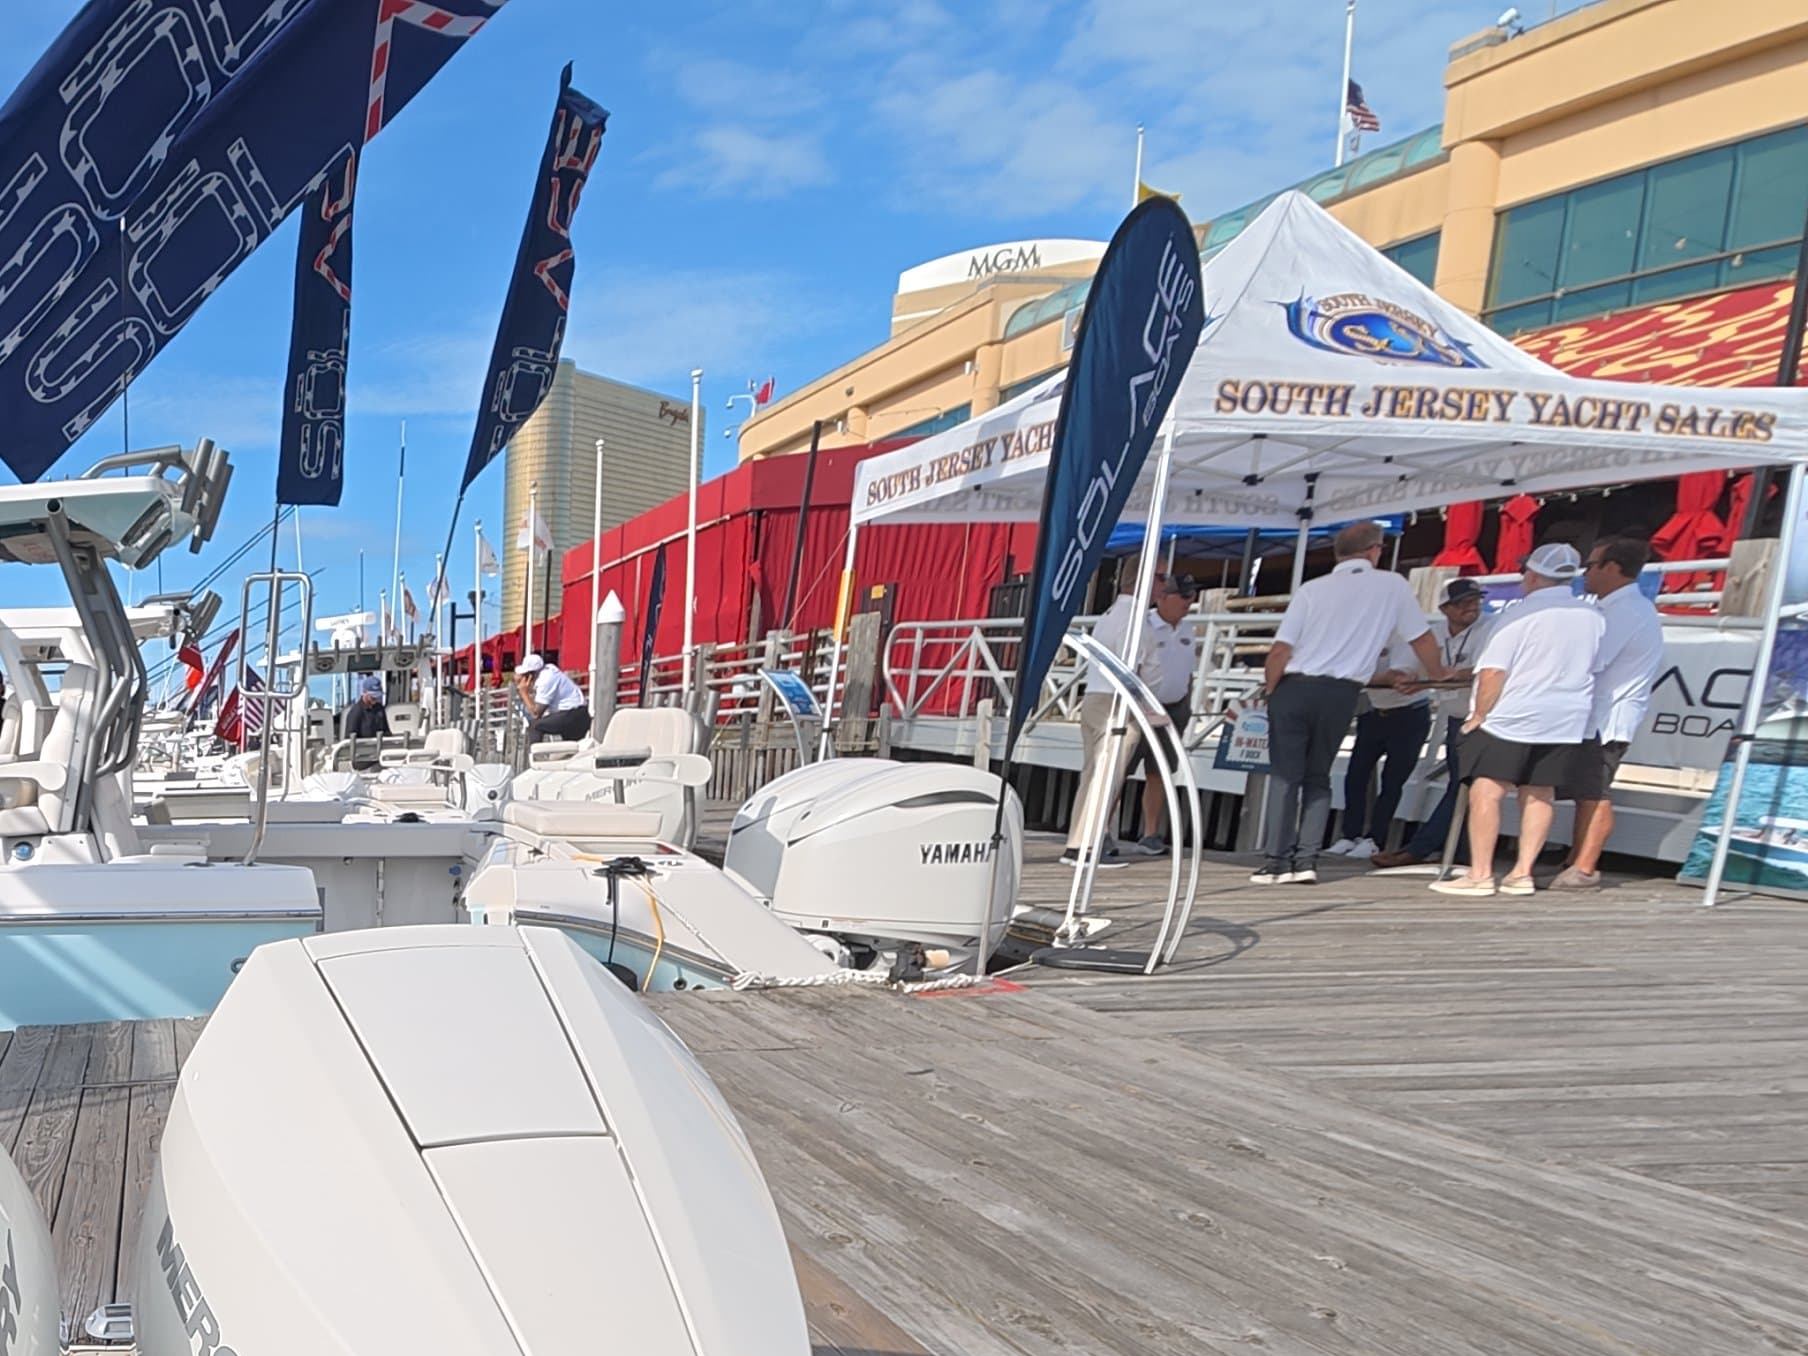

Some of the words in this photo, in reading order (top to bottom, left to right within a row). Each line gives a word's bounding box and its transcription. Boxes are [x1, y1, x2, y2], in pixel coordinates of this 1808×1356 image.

[968, 243, 1041, 277] MGM
[1215, 379, 1353, 418] SOUTH
[1360, 384, 1518, 424] JERSEY
[1524, 393, 1650, 433] YACHT
[1654, 399, 1778, 442] SALES
[867, 465, 921, 507] SOUTH
[925, 437, 993, 488] JERSEY
[998, 418, 1056, 462] YACH
[1651, 712, 1736, 738] BOA
